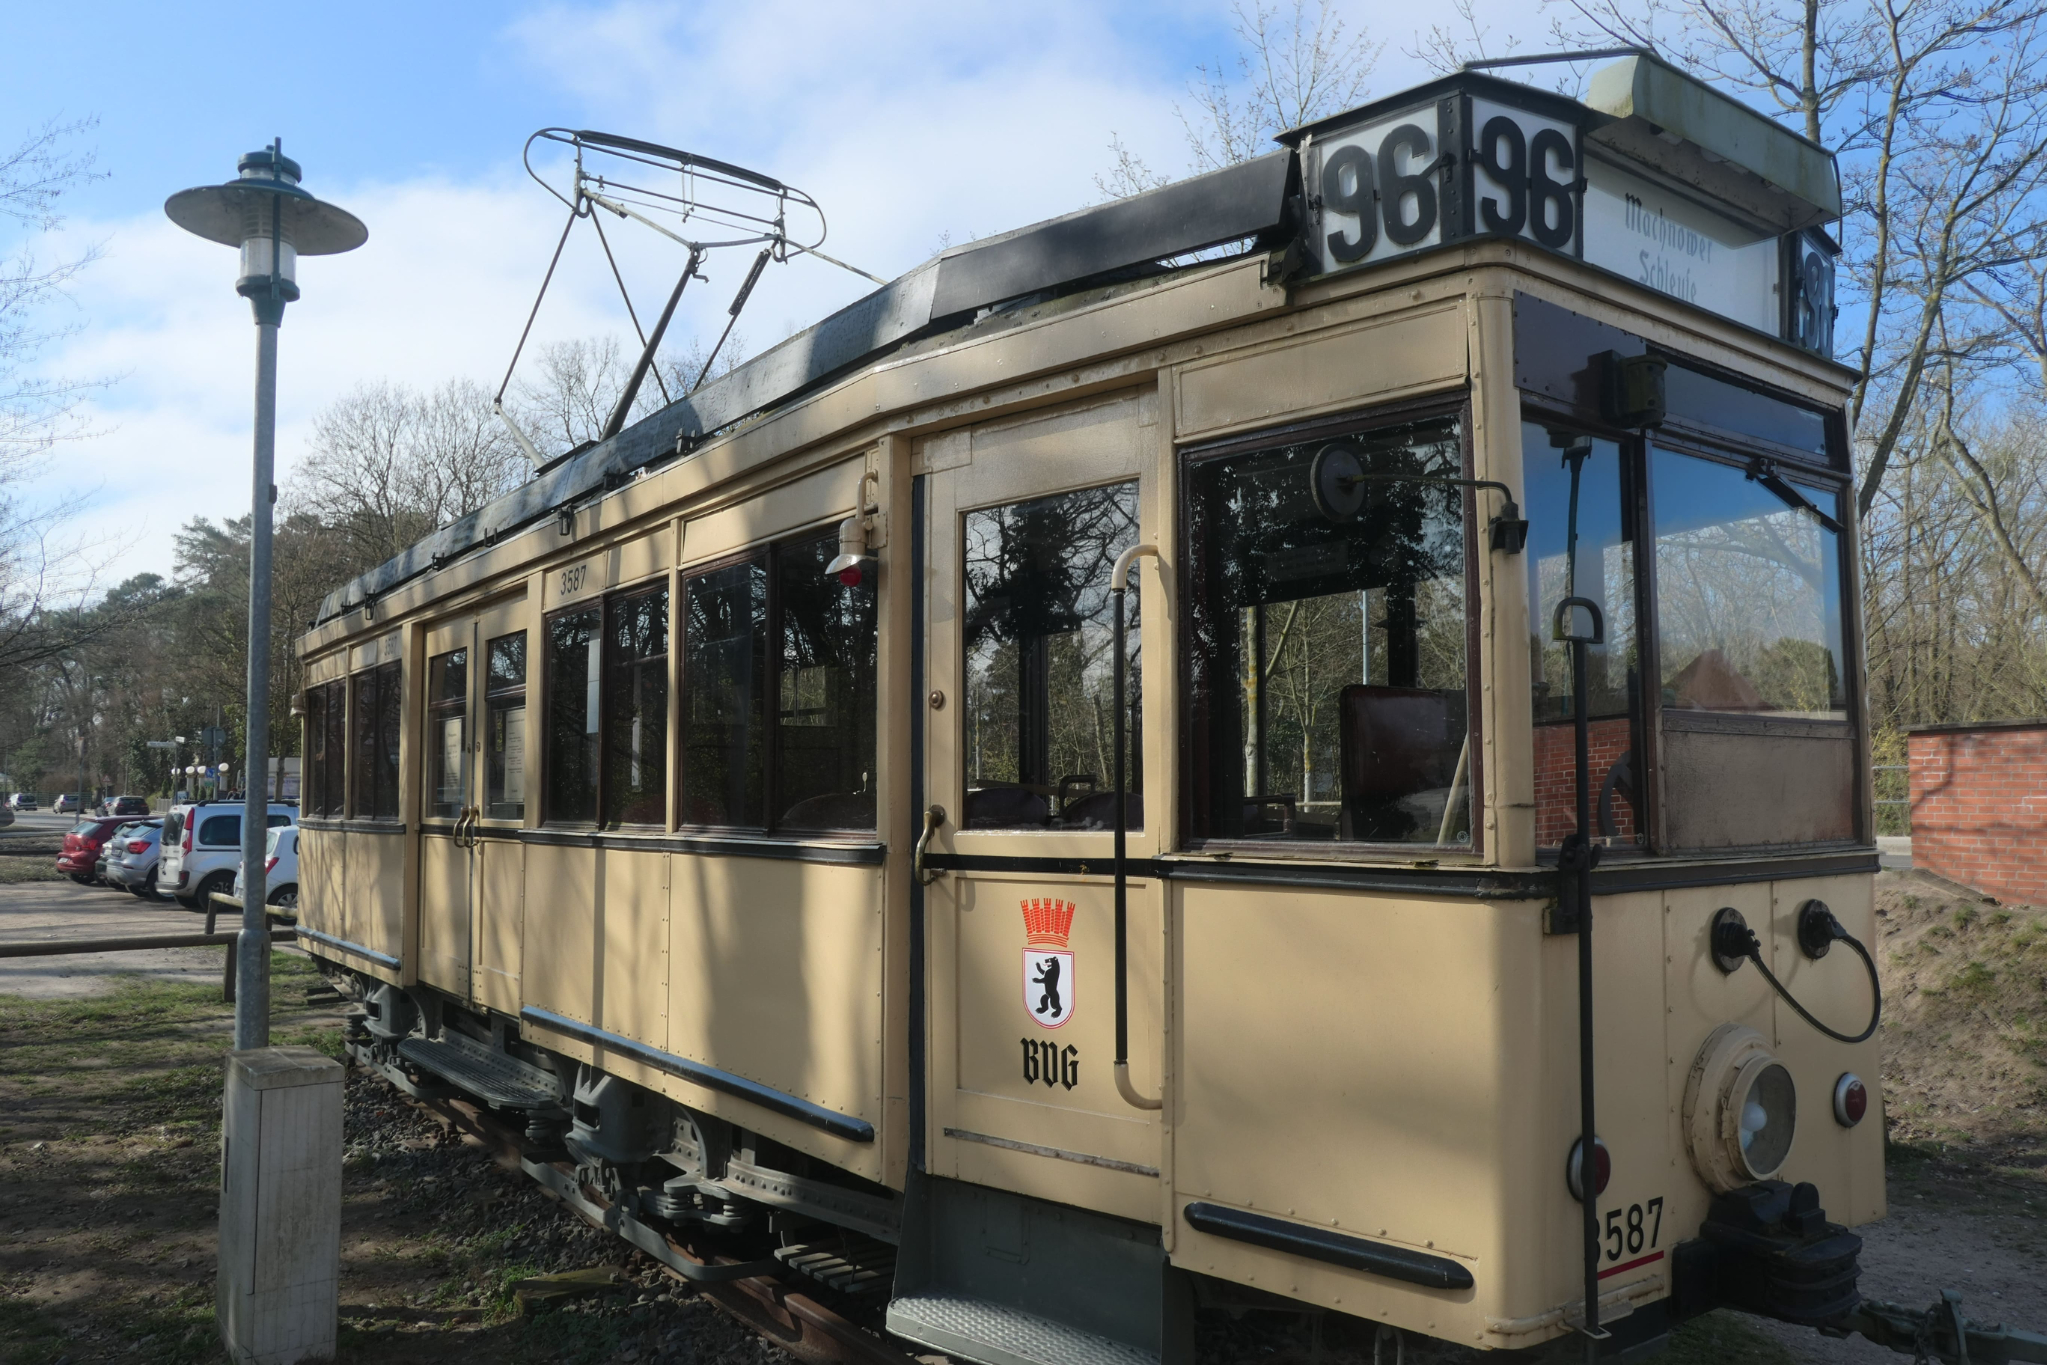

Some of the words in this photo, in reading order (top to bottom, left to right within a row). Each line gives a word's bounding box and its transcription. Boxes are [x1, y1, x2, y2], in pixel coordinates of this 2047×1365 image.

[1323, 123, 1437, 263] 96
[1481, 116, 1574, 248] 96
[1625, 192, 1713, 264] Machnower
[560, 564, 587, 596] 3587
[1020, 1037, 1079, 1091] BVG
[1596, 1196, 1664, 1264] 587
